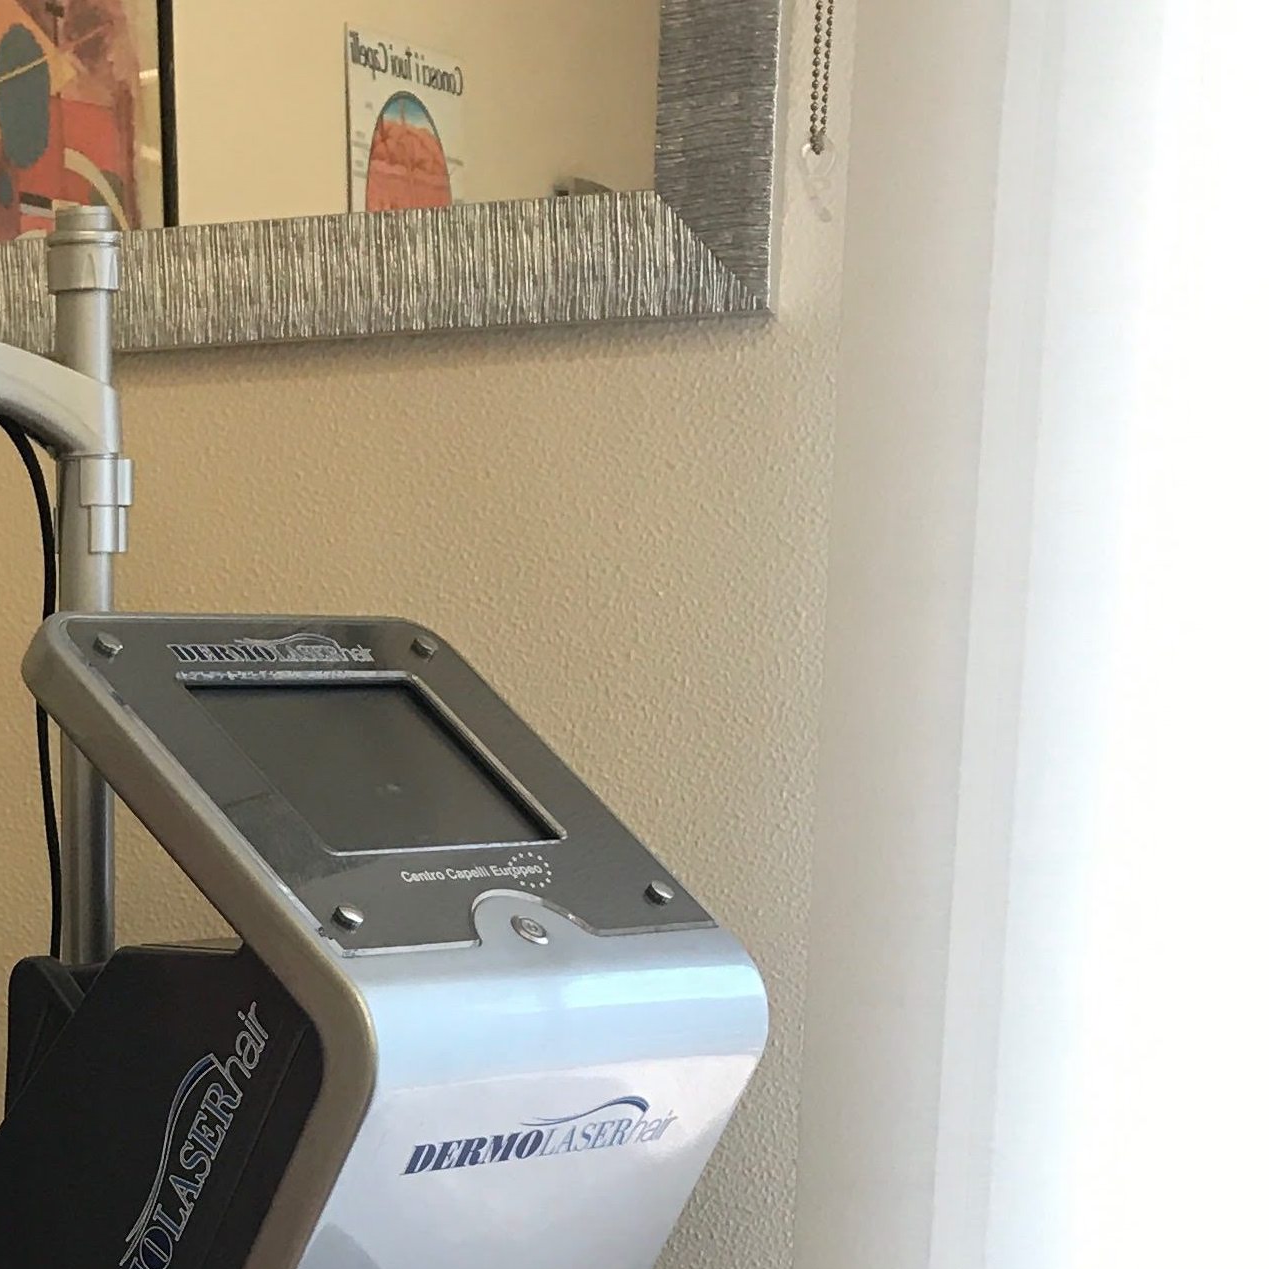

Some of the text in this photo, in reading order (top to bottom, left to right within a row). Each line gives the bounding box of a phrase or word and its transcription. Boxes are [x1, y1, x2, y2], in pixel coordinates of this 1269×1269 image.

[400, 864, 543, 883] Centro Capelli Europeo
